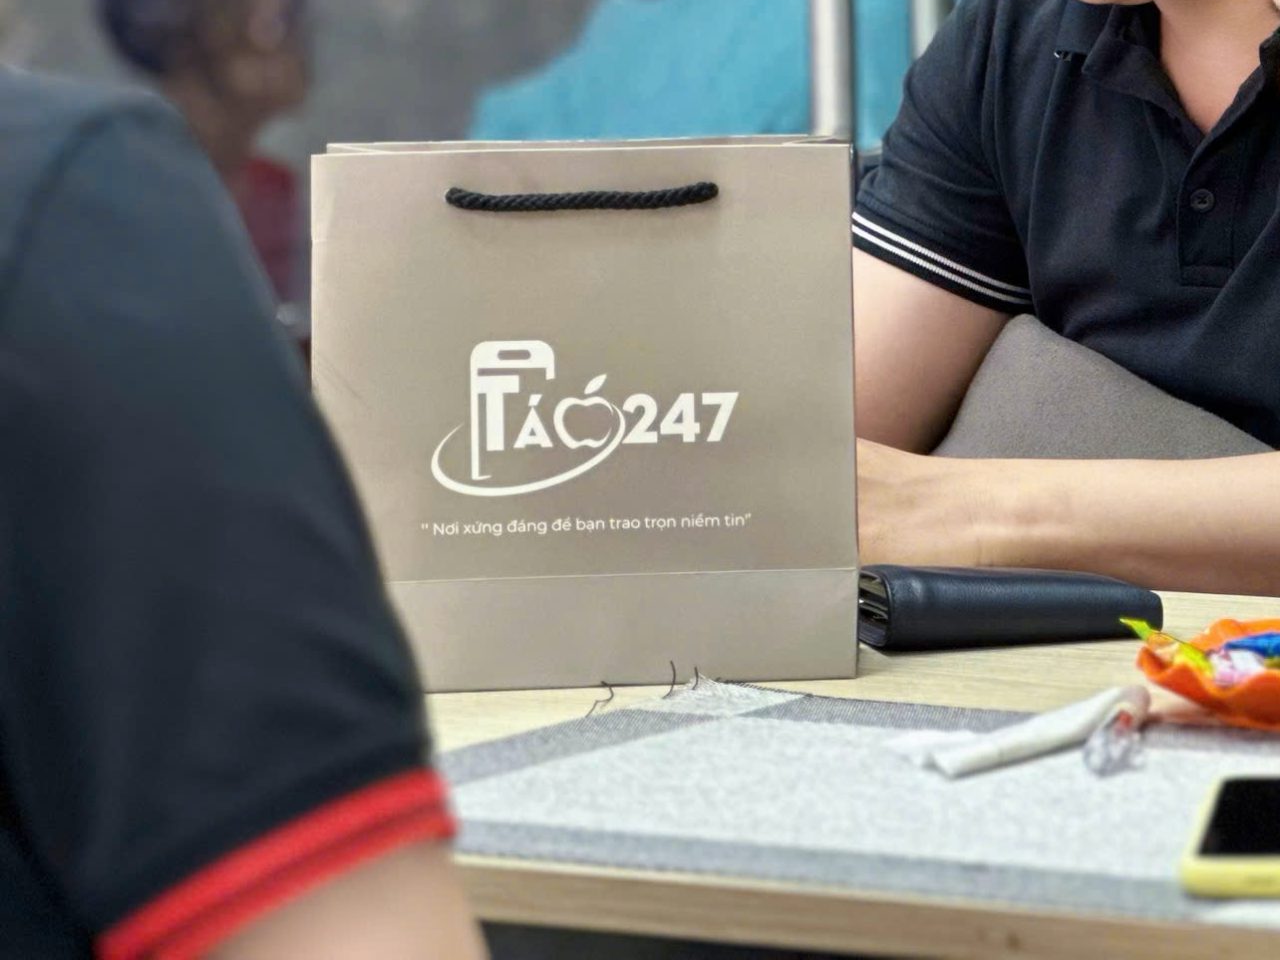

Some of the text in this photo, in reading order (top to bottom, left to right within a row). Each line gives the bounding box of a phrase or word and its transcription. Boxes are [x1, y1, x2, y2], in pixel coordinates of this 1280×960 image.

[507, 518, 548, 535] đáng
[576, 517, 605, 533] bạn
[609, 517, 641, 530] trao
[644, 516, 677, 531] trọn
